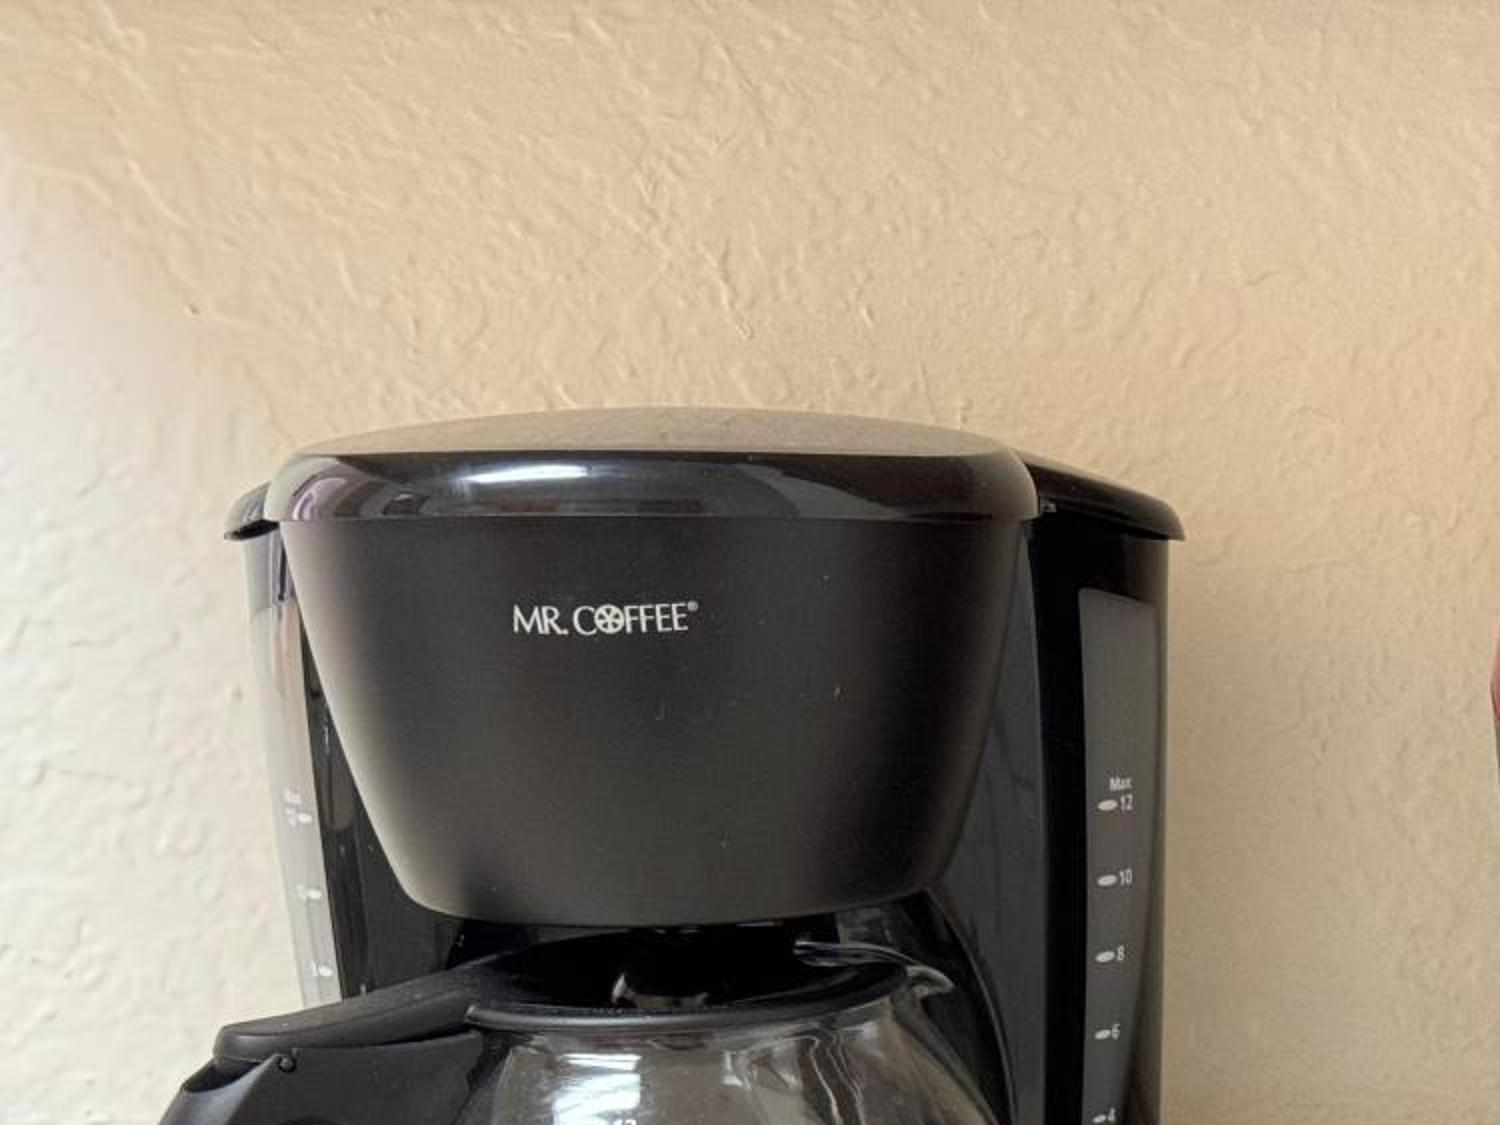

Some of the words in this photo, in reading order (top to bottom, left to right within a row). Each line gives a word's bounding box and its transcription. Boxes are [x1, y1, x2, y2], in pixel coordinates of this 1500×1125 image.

[513, 604, 568, 635] MR.
[573, 602, 689, 636] COFFEE
[1121, 794, 1133, 811] 12
[1120, 868, 1133, 886] 10
[1117, 945, 1125, 961] 8
[1111, 1023, 1120, 1039] 6
